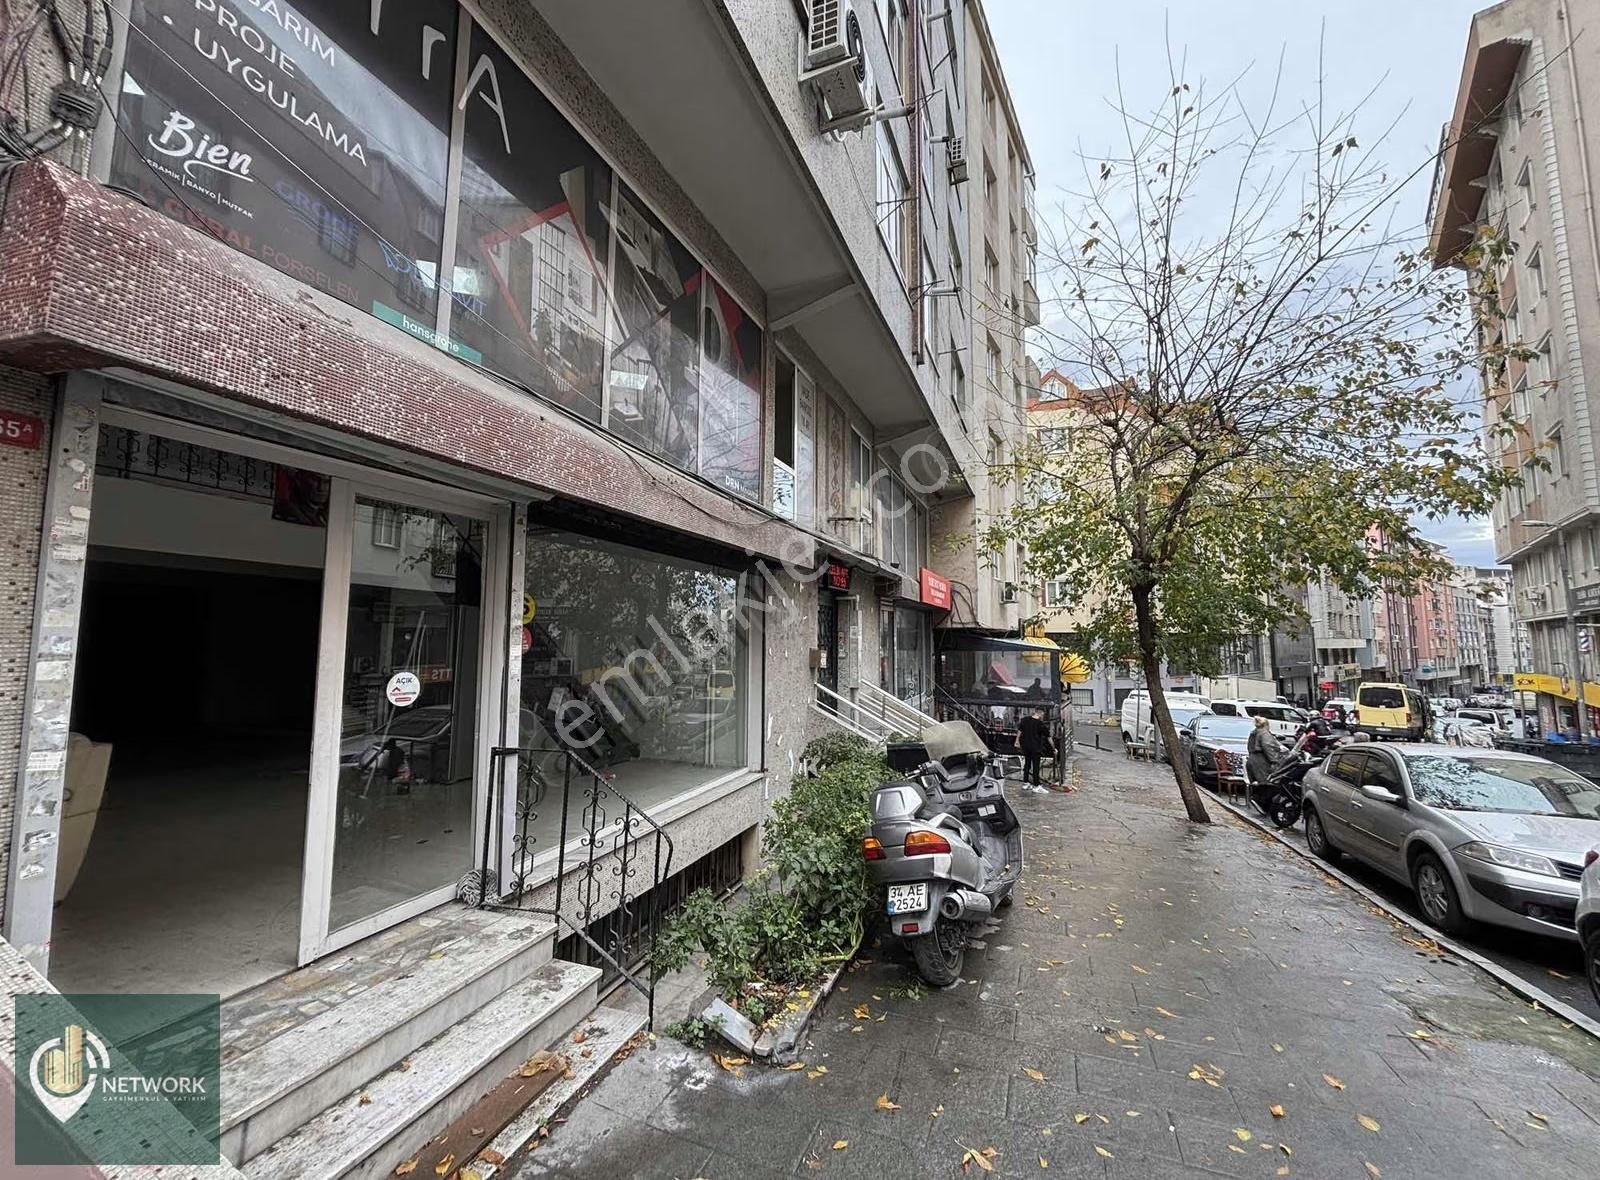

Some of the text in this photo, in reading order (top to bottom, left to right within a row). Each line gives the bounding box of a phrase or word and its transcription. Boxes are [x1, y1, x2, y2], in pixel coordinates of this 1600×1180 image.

[247, 0, 335, 67] ARIM
[194, 28, 367, 167] UYGULAMA
[148, 110, 253, 180] Bien
[896, 897, 922, 911] 2524
[907, 884, 924, 897] AE
